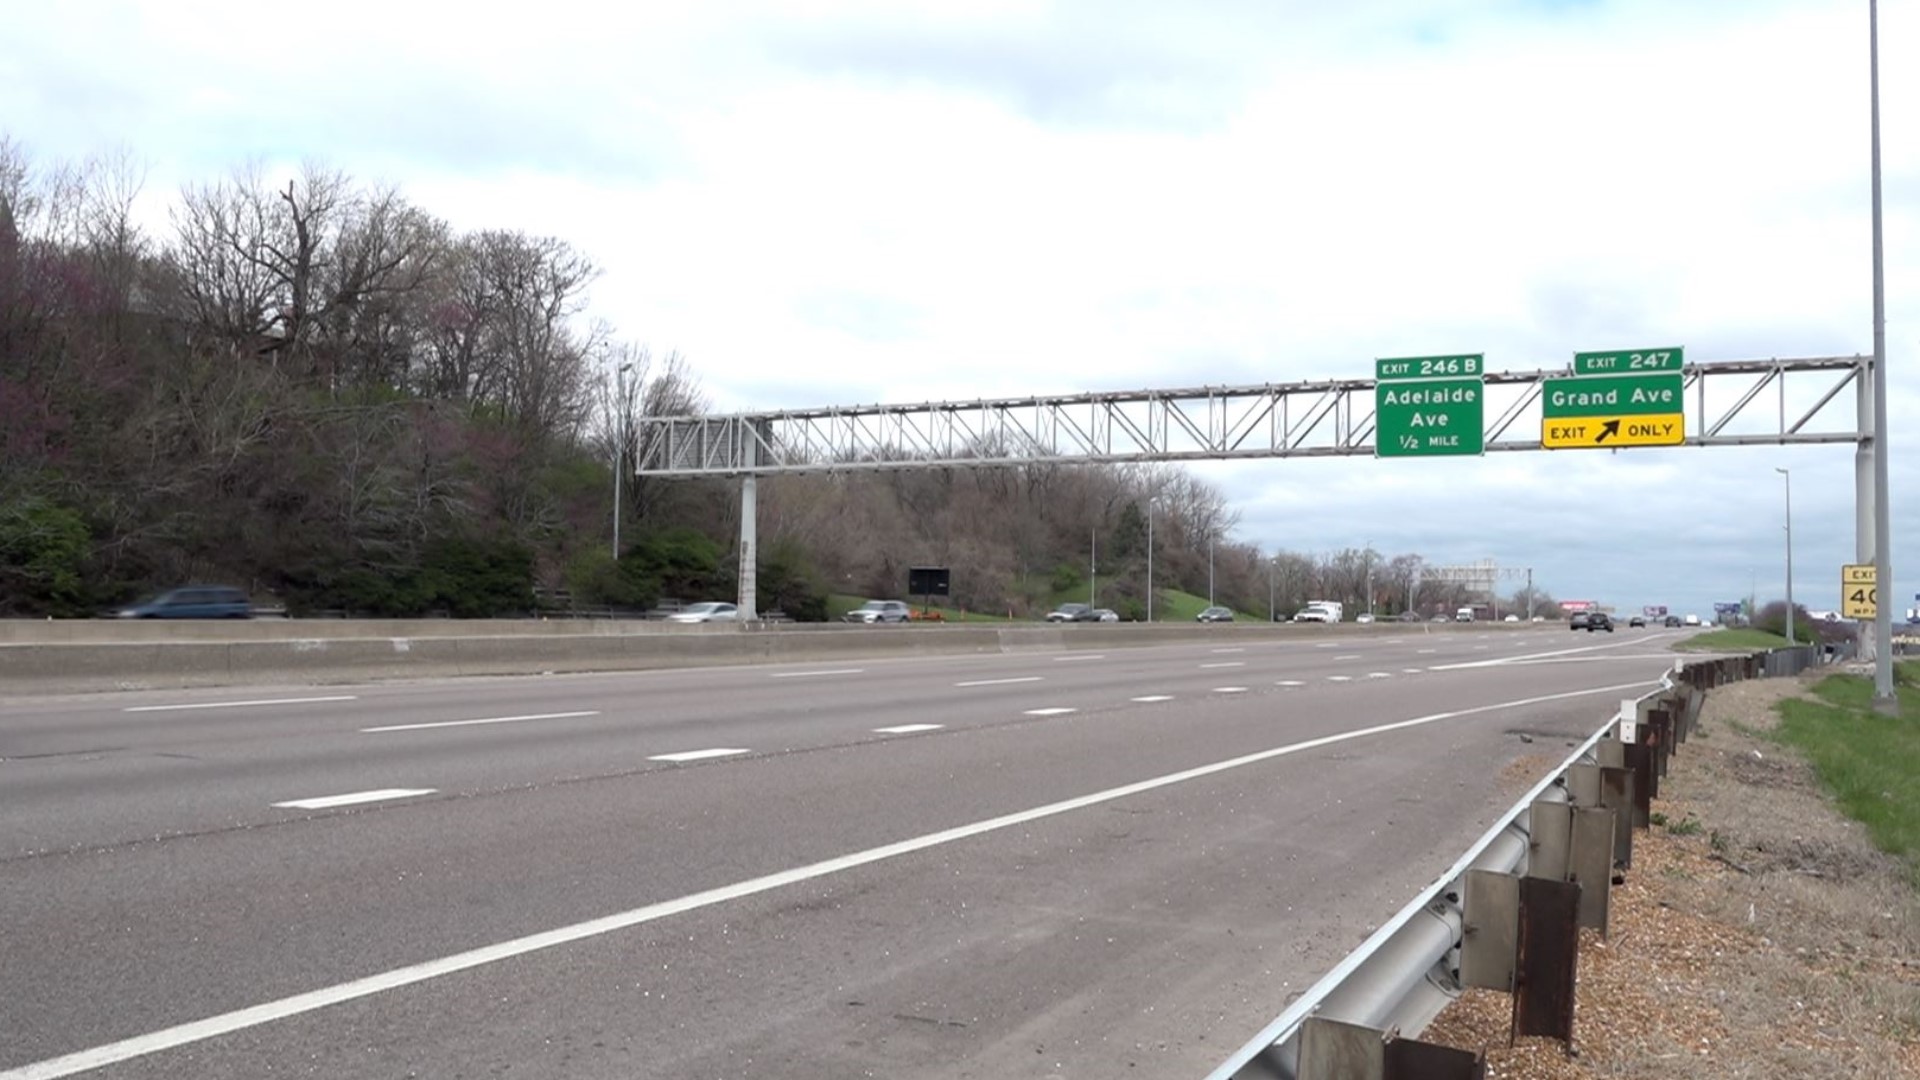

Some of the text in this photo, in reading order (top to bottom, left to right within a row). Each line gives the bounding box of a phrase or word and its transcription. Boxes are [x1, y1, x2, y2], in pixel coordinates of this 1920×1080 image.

[1382, 358, 1477, 375] EXIT 246 B
[1586, 352, 1671, 369] EXIT 247
[1384, 388, 1476, 405] Adelaide
[1551, 387, 1673, 407] Grand Ave
[1410, 412, 1449, 427] Ave
[1550, 423, 1674, 439] EXIT ONLY
[1429, 435, 1459, 446] MILE
